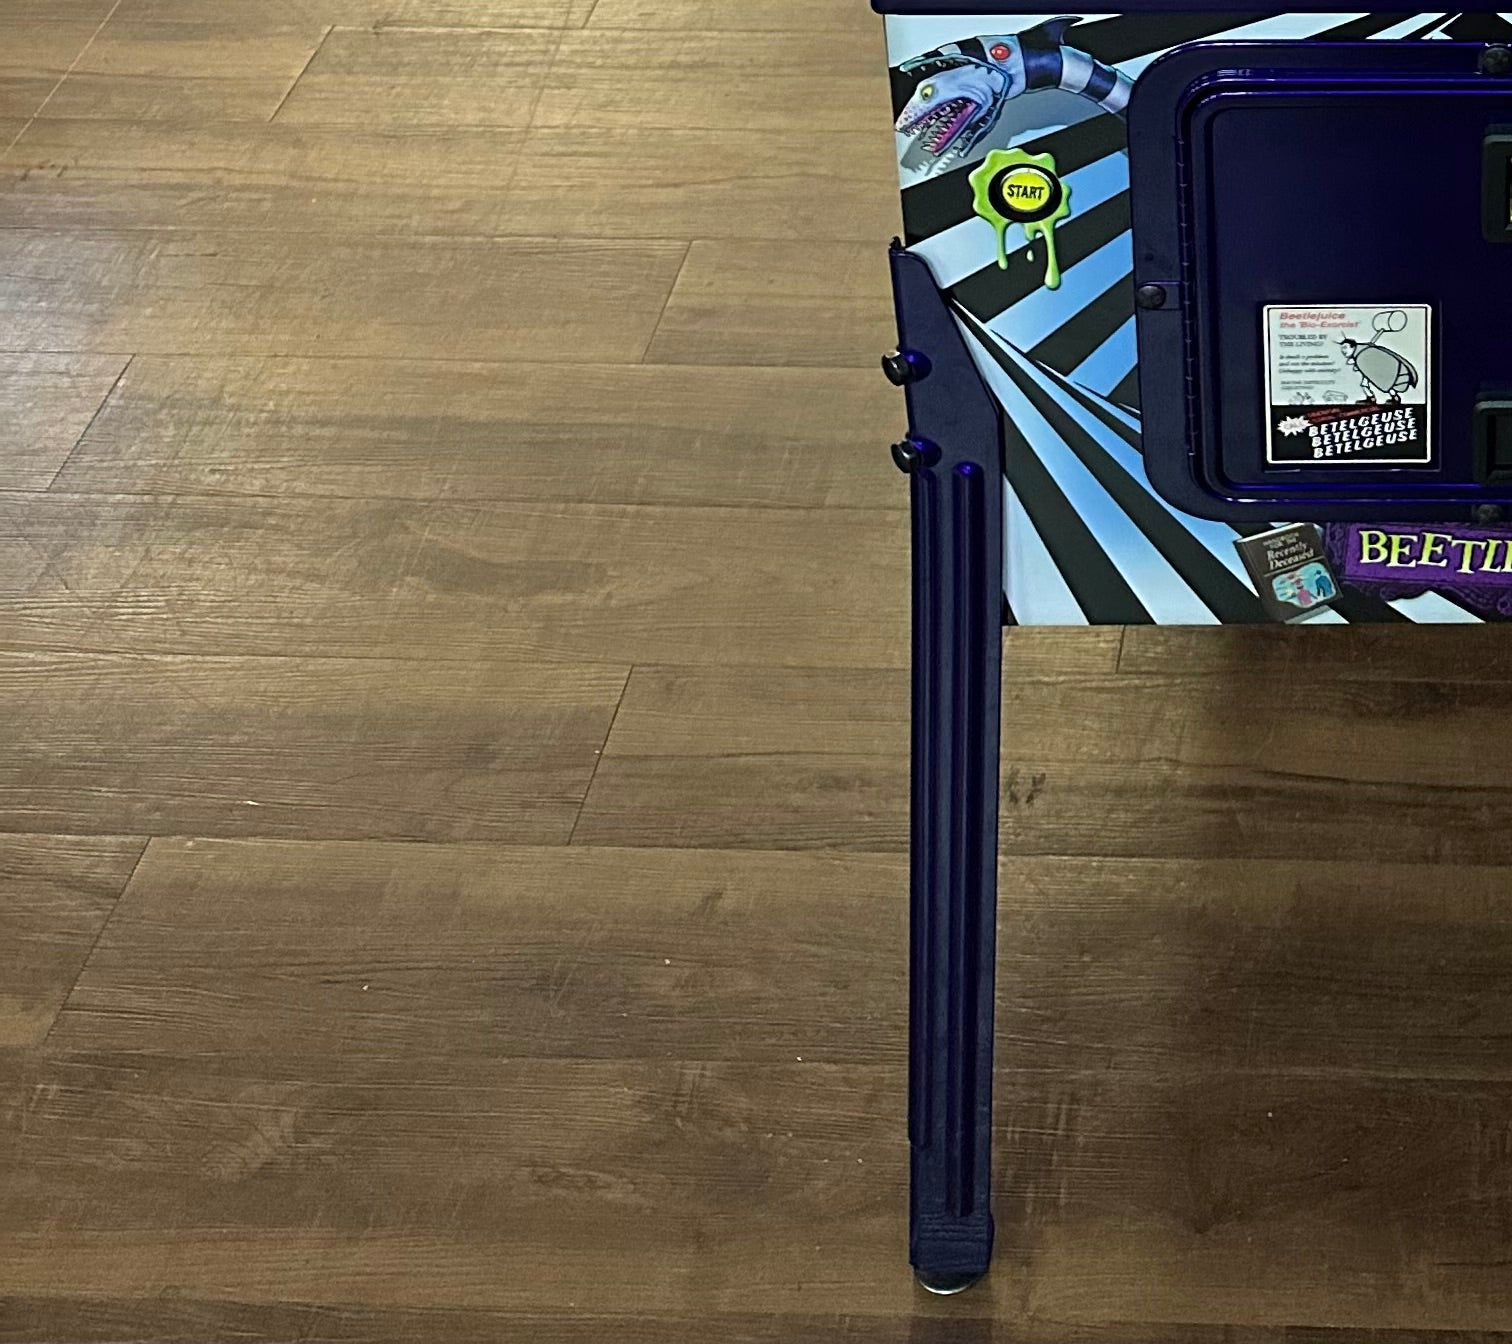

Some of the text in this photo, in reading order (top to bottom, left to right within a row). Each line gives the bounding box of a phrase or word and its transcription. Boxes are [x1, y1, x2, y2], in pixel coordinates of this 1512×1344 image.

[1007, 183, 1045, 201] START
[1279, 312, 1346, 322] Beetlejuice
[1308, 407, 1414, 437] BETELGEUSE
[1311, 418, 1416, 447] BETELGEUSE
[1313, 428, 1418, 459] BETELGEUSE
[1266, 541, 1308, 561] Recently
[1268, 547, 1315, 571] Deceased
